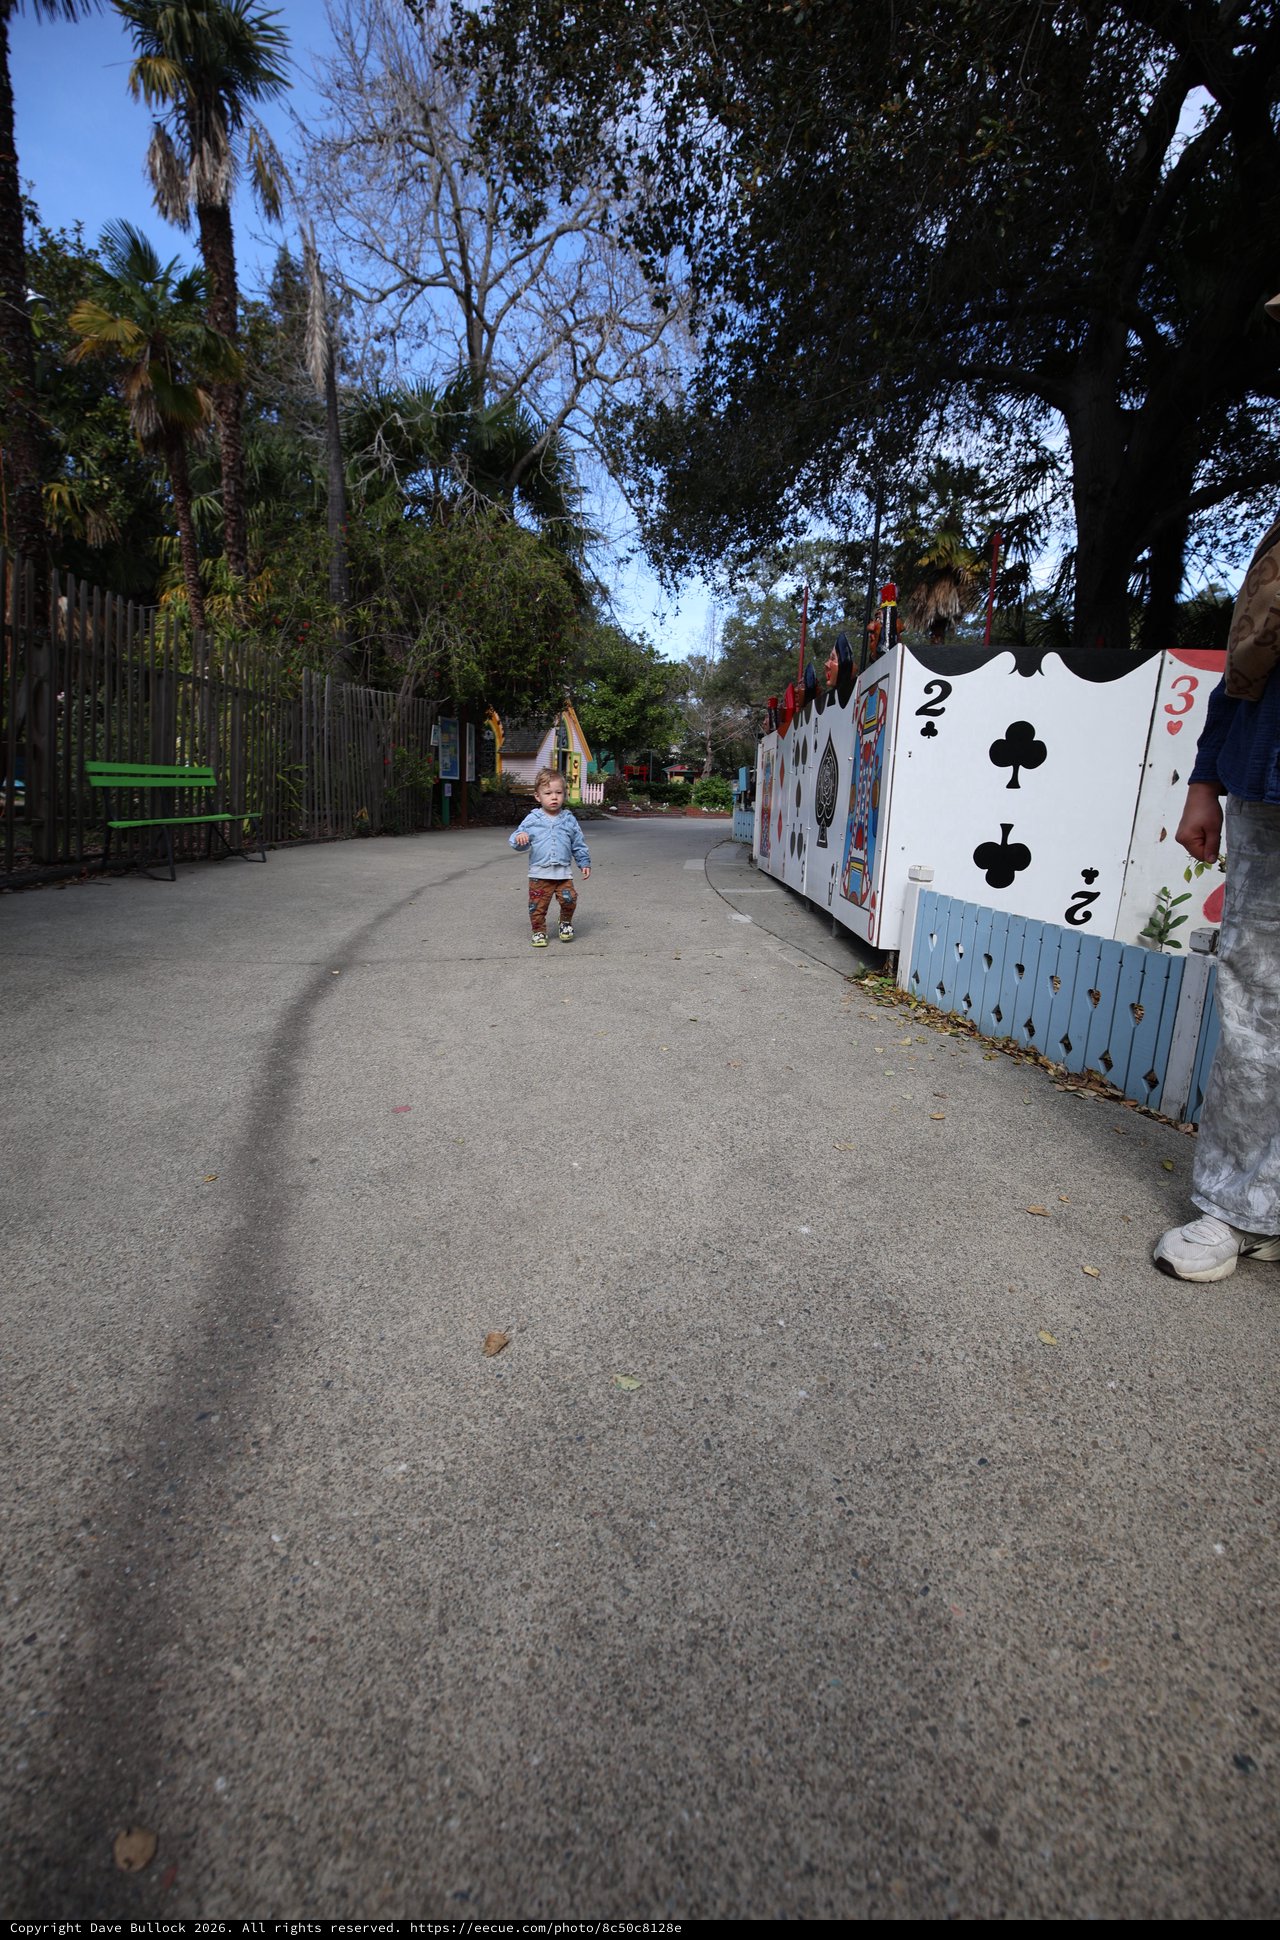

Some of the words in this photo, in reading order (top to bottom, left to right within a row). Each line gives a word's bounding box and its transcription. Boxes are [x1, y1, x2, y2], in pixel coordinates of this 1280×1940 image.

[915, 678, 953, 718] 2
[1164, 675, 1199, 716] 3
[1064, 890, 1101, 926] 2
